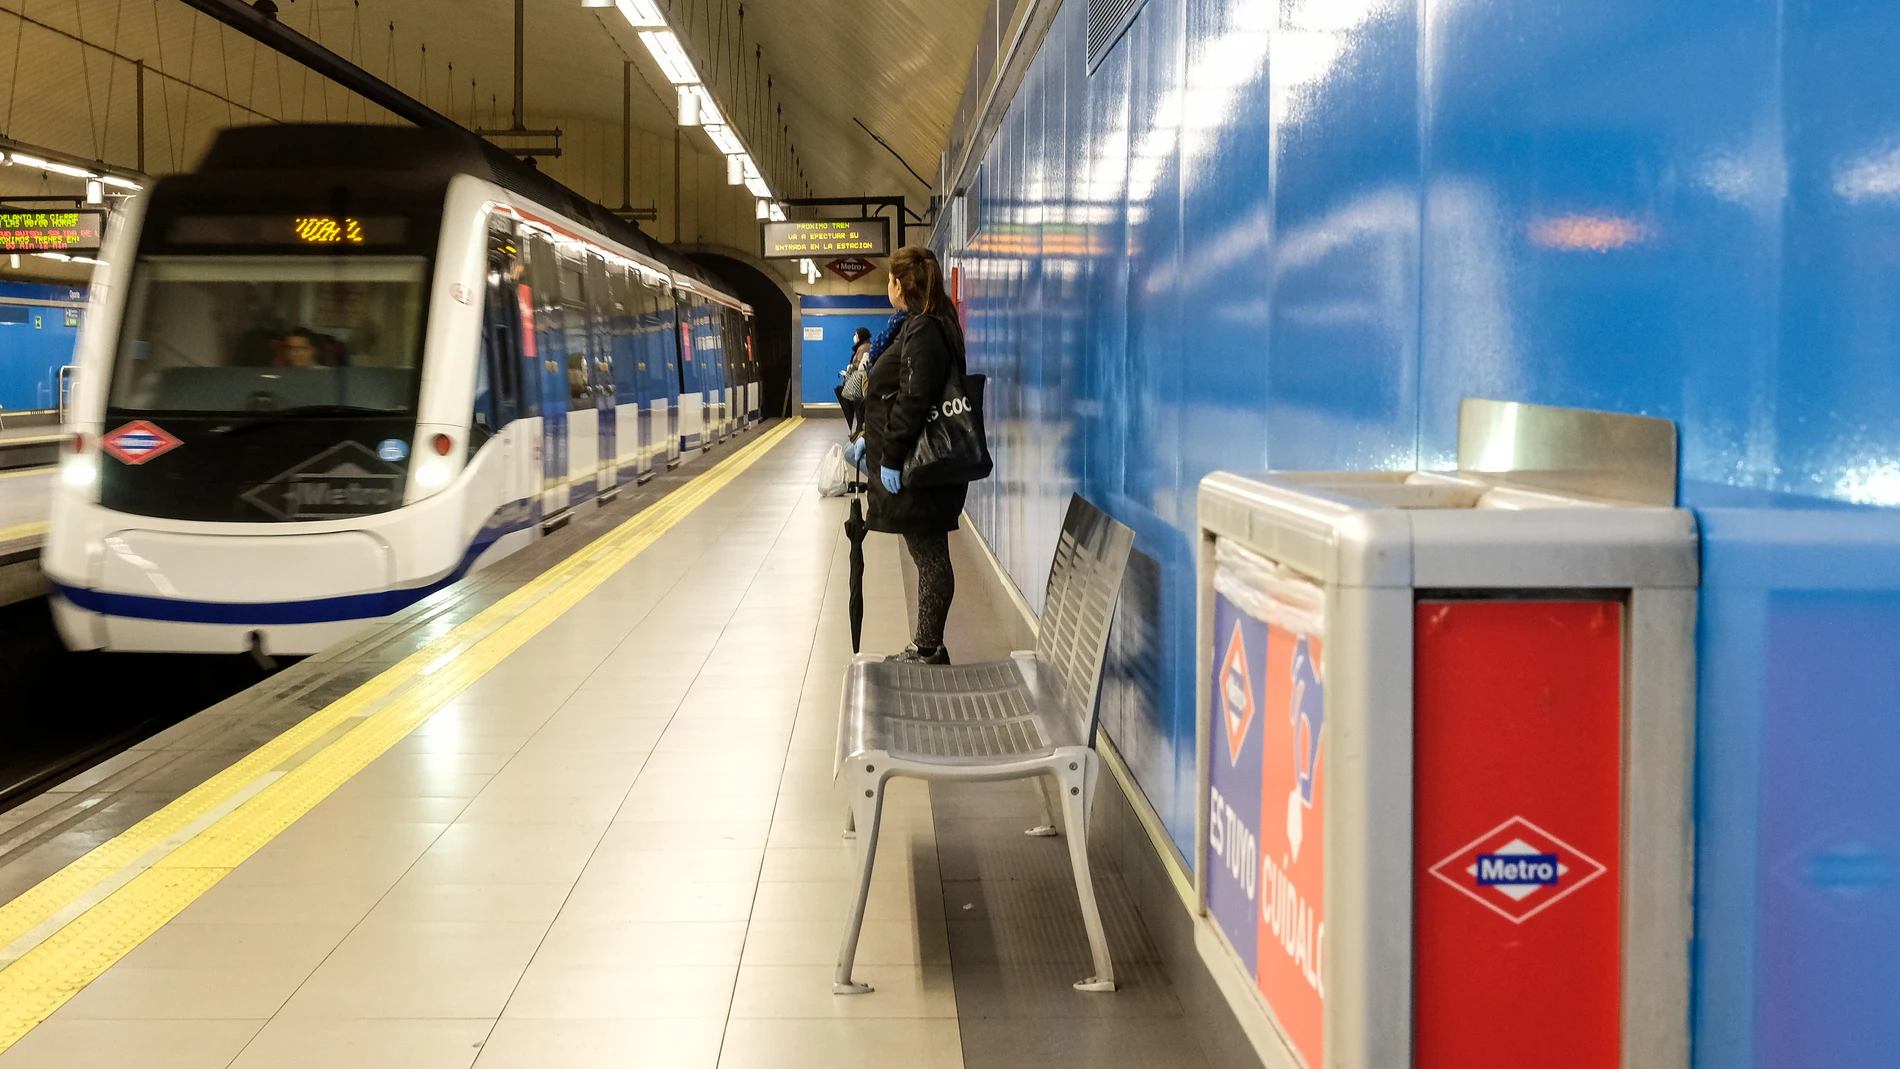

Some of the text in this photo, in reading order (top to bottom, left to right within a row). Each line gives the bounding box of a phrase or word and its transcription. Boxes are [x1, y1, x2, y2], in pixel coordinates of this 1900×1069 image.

[797, 222, 828, 230] PROXIMO
[34, 236, 62, 244] TRENES
[836, 242, 873, 250] ESTACION
[300, 482, 393, 506] Metro
[1209, 785, 1257, 900] ES TUYO
[1481, 858, 1553, 881] Metro
